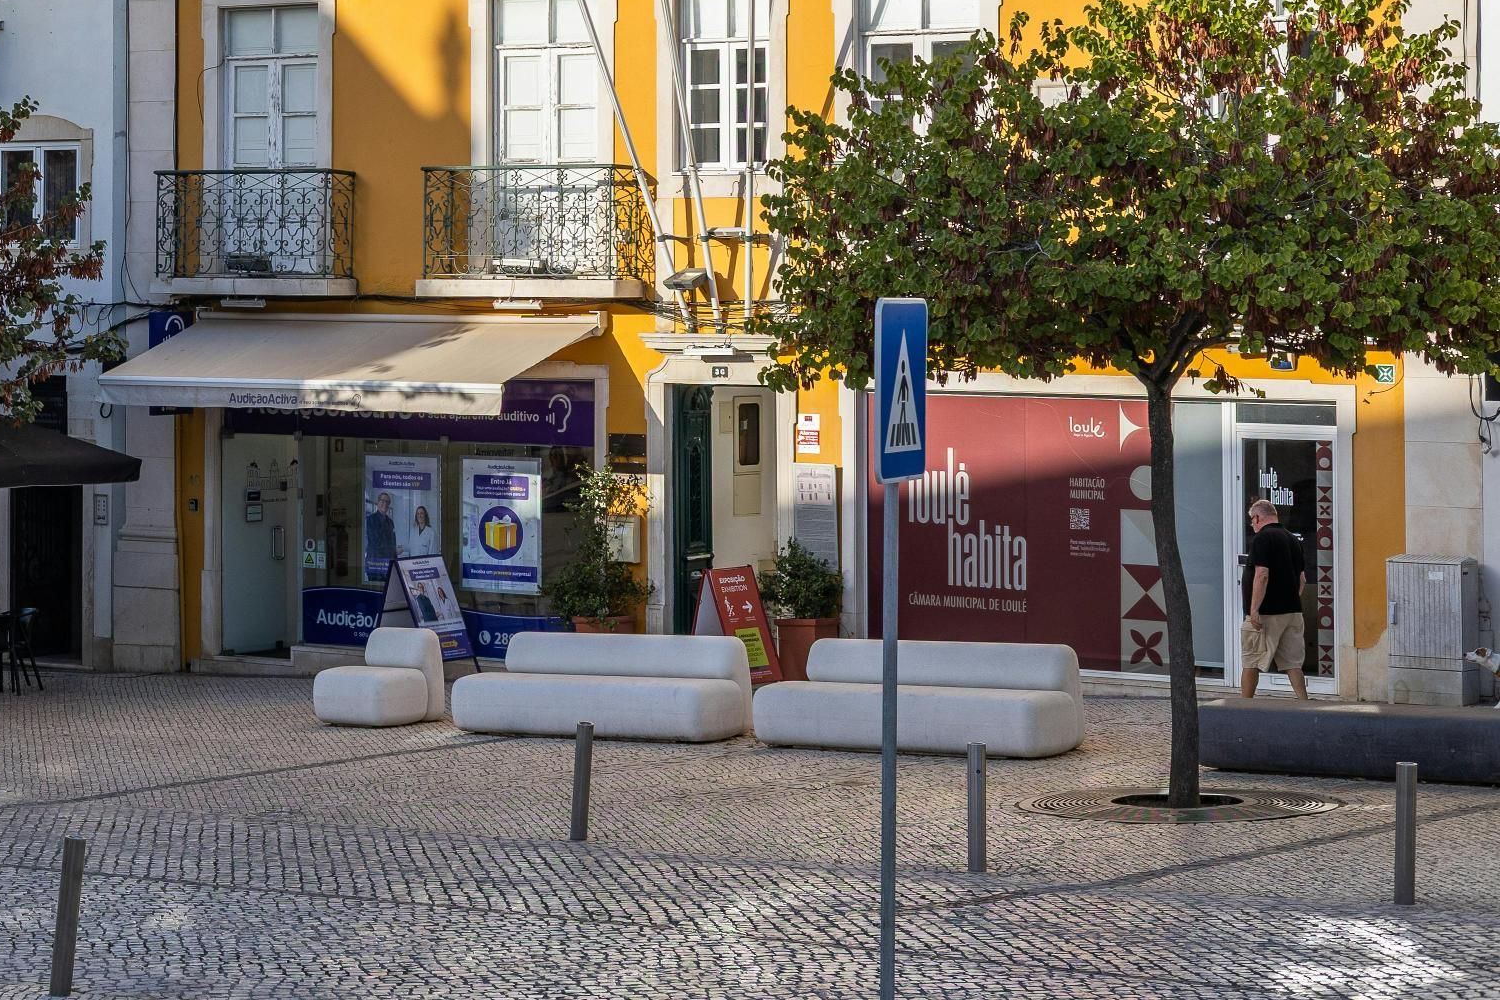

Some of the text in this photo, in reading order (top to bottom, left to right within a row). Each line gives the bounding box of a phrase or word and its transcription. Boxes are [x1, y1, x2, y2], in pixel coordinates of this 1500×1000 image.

[228, 392, 298, 407] AudiçãoActiva
[497, 410, 540, 423] auditivo
[1069, 416, 1105, 438] loulé
[908, 447, 970, 526] loulé
[1069, 477, 1105, 490] HABITAÇÃO
[1259, 467, 1278, 489] loulé
[1069, 489, 1105, 500] MUNICIPAL
[1270, 486, 1294, 506] habita
[947, 517, 1027, 591] habita
[718, 574, 746, 584] EXPOSIÇÃO
[721, 584, 748, 593] EXHIBITION
[908, 591, 1027, 613] CÂMARA MUNICIPAL DE LOULÉ
